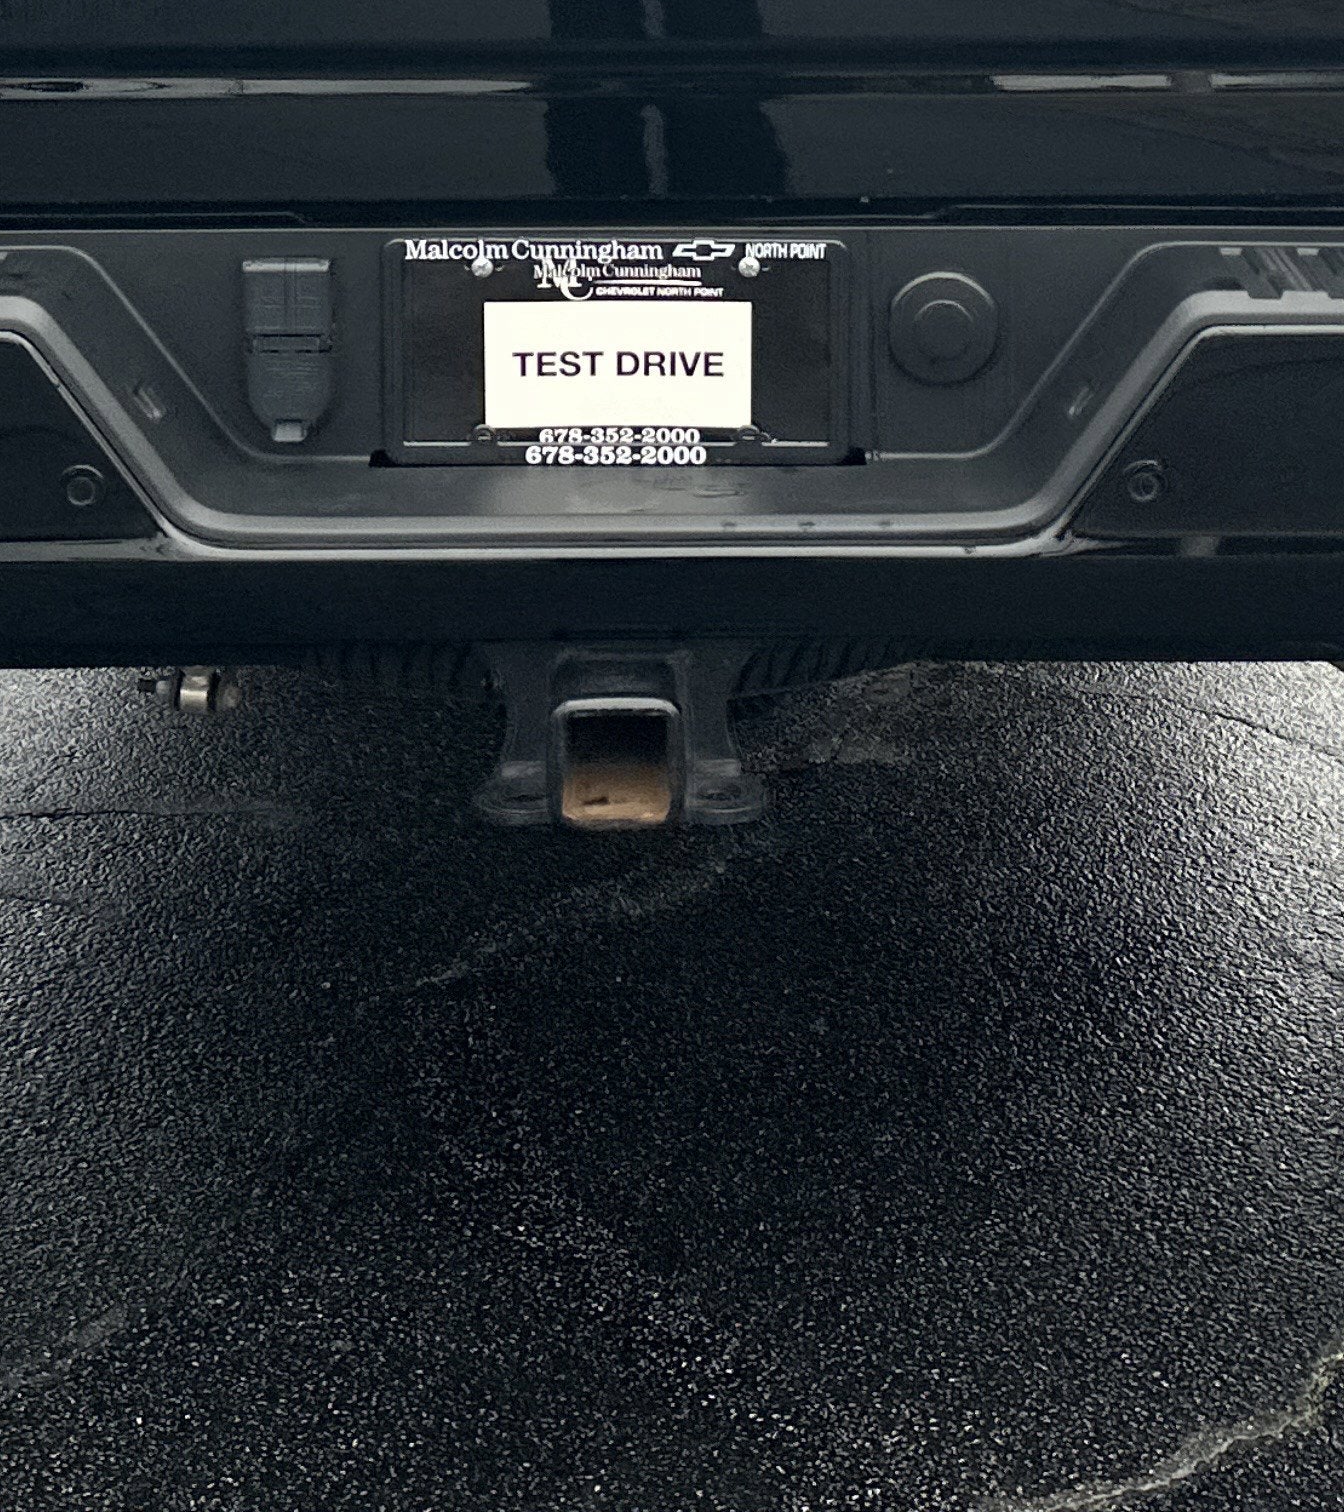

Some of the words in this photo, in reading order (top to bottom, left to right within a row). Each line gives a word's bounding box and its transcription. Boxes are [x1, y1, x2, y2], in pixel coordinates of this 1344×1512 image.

[405, 239, 508, 260] Malcolm
[511, 240, 664, 264] Cunningham
[745, 243, 788, 259] NORTH
[790, 243, 827, 259] POINT
[602, 264, 702, 280] Cunningham
[595, 287, 654, 297] CHEVROLET
[656, 287, 691, 297] NORTH
[693, 287, 724, 298] POINT
[512, 352, 604, 377] TEST
[616, 352, 725, 377] DRIVE
[539, 428, 700, 444] 678-352-2000
[525, 445, 707, 464] 678-352-2000
